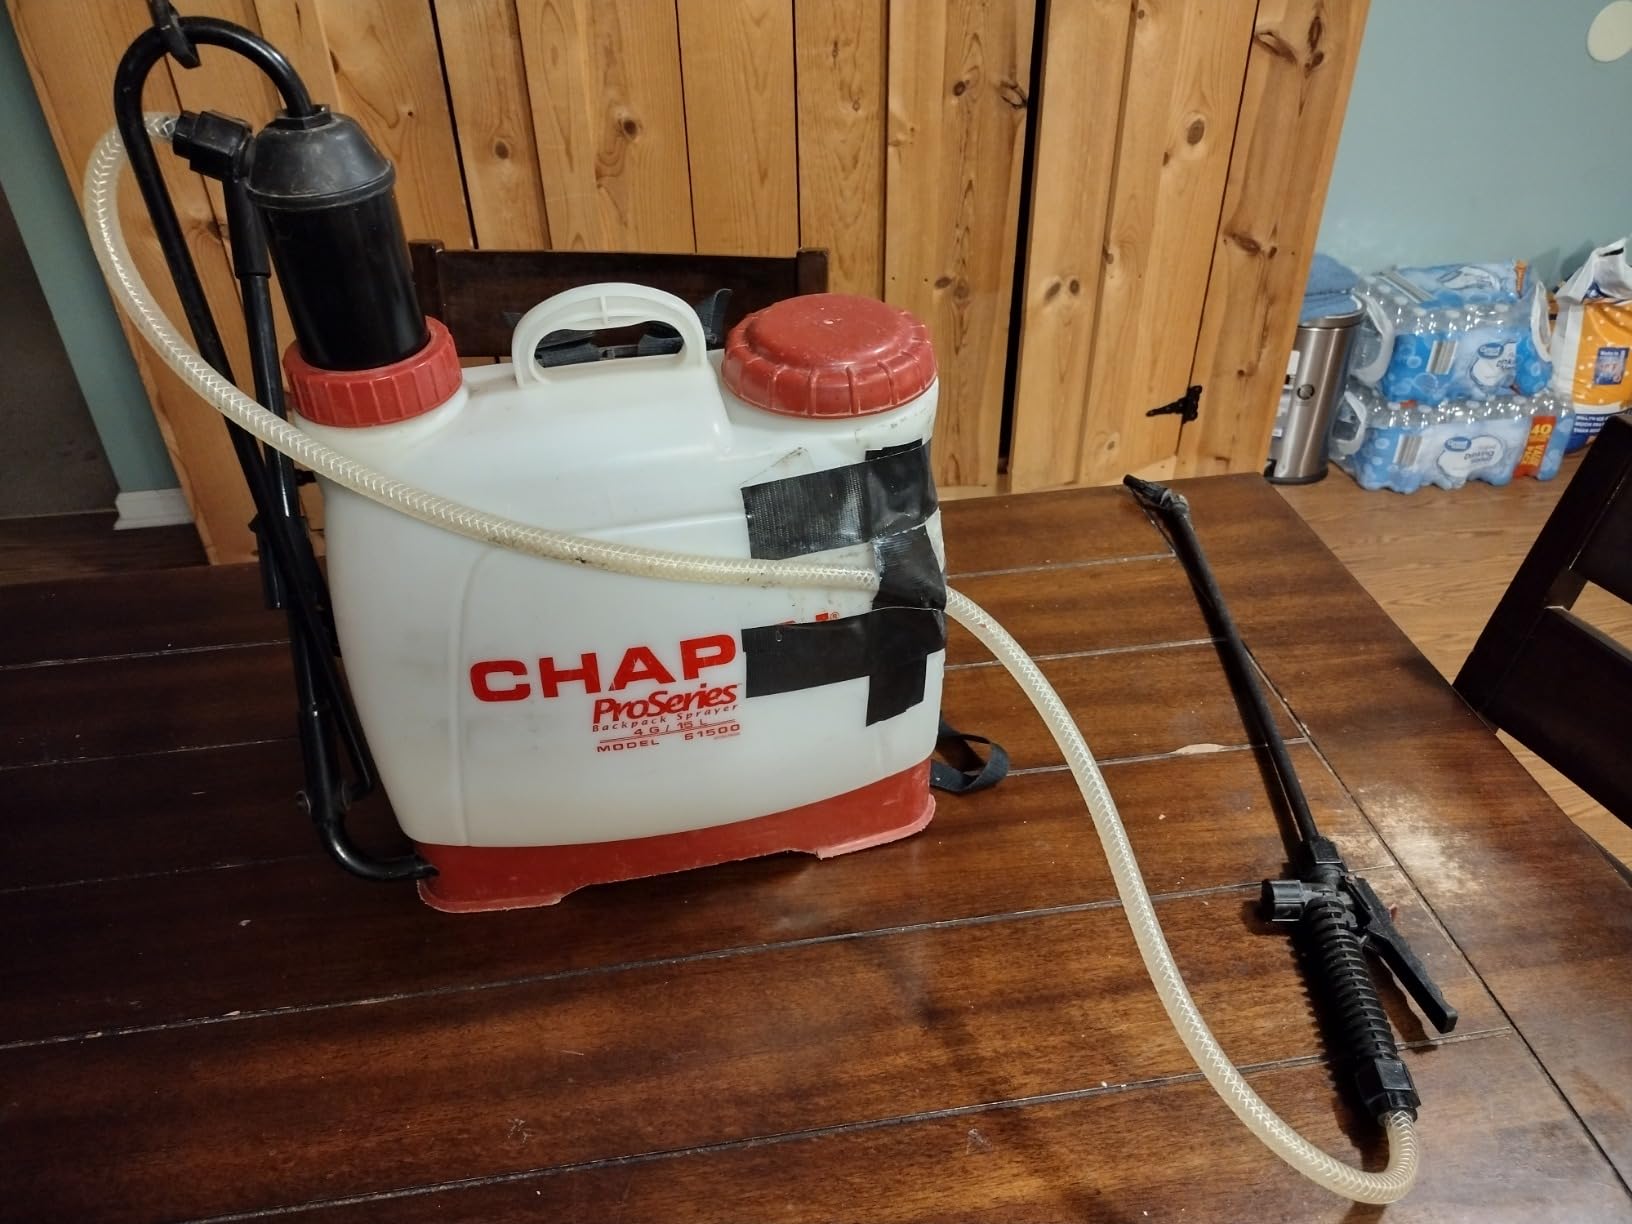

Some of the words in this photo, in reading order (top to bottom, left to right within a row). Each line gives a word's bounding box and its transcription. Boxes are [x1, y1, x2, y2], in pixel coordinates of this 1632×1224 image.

[592, 683, 738, 724] ProSeries
[592, 716, 667, 732] Backpack
[676, 704, 738, 721] Sprayer
[597, 739, 660, 753] MODEL
